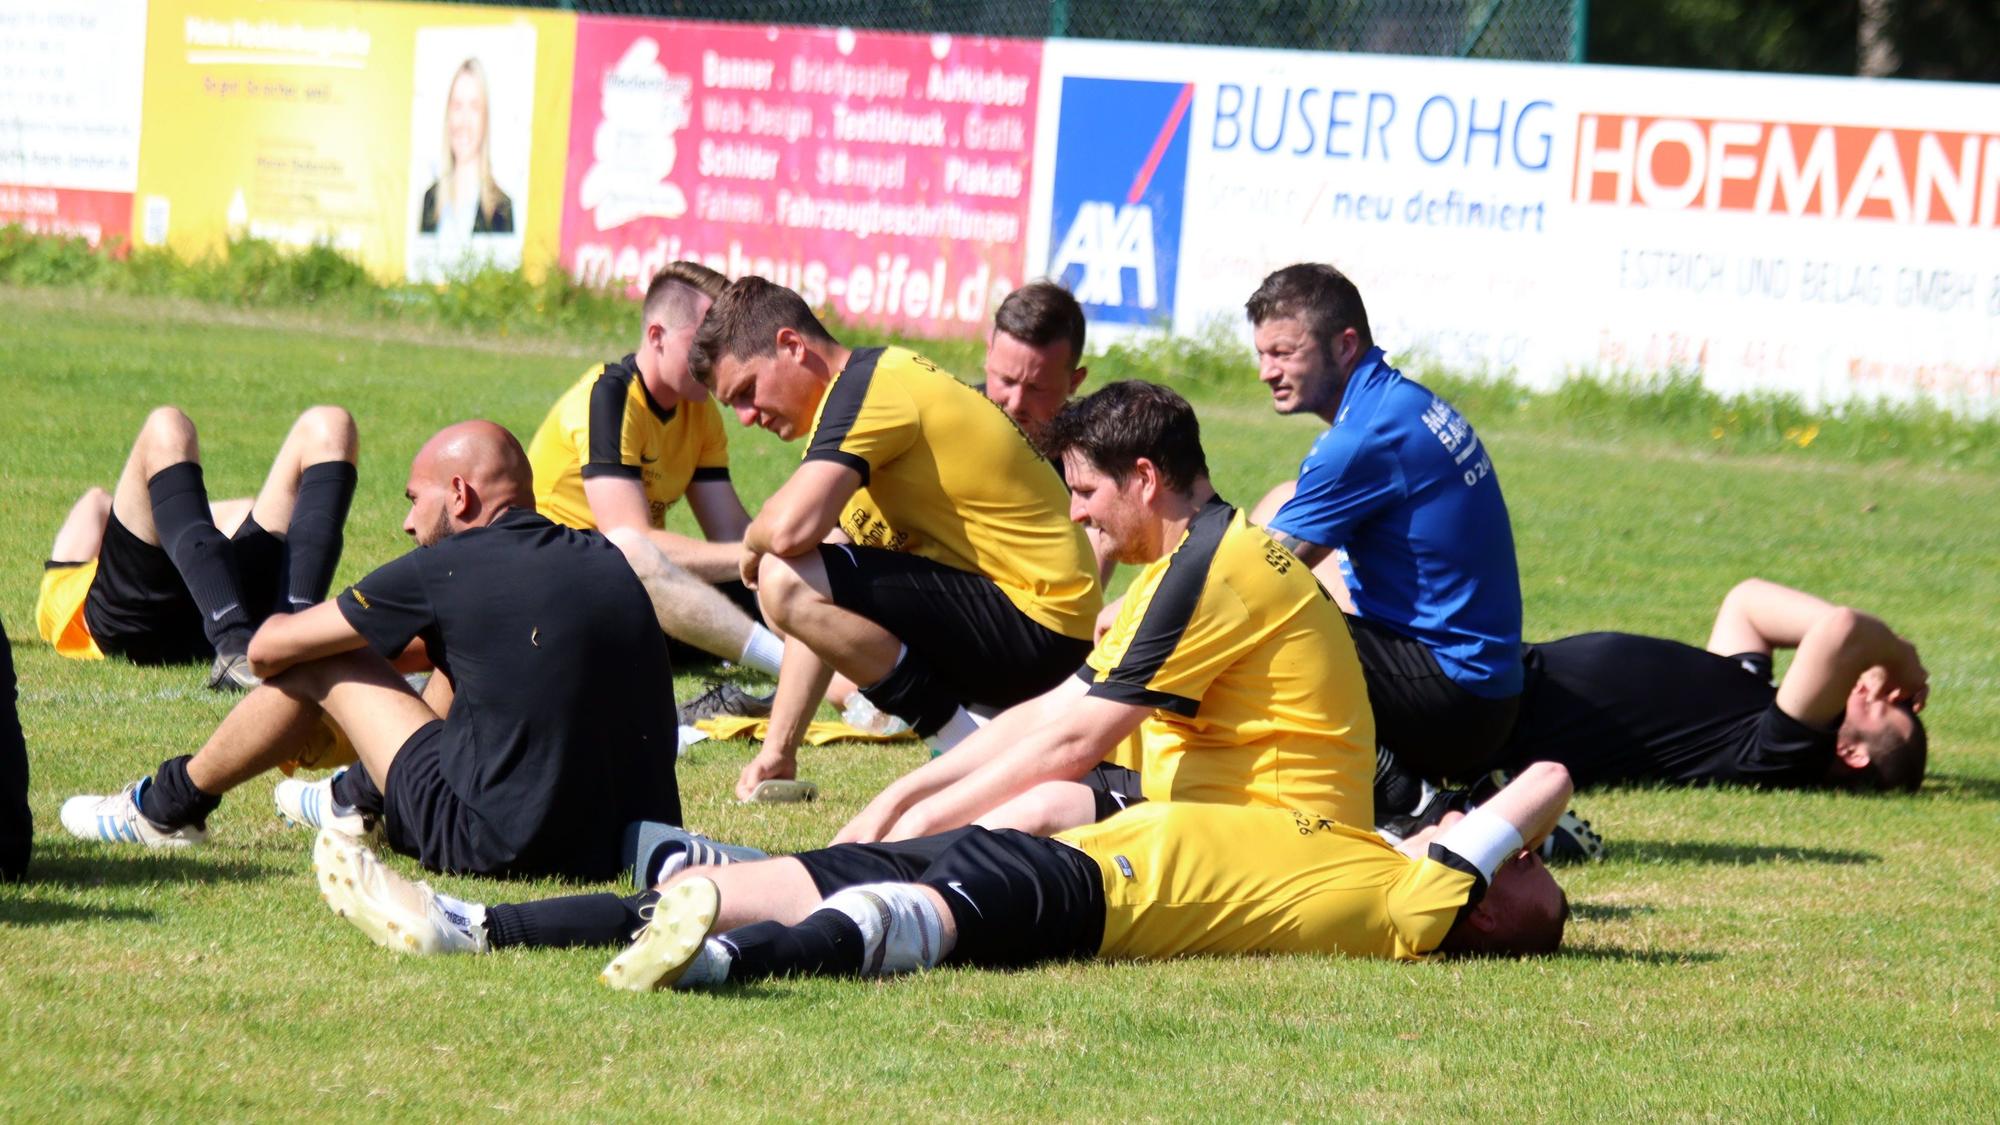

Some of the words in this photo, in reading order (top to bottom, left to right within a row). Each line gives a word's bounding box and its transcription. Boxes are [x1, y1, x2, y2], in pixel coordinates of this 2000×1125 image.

[703, 49, 775, 91] Banner
[790, 54, 910, 103] Briefpapier
[926, 63, 1029, 107] Aufkleber
[702, 97, 813, 144] Web-Design
[832, 102, 946, 147] Textildruck
[963, 110, 1025, 152] Grafik
[1211, 67, 1398, 163] BÜSER
[1415, 92, 1557, 173] OHG
[698, 138, 780, 181] Schilder
[944, 156, 1023, 199] Plakate
[1331, 189, 1394, 223] neu
[1402, 187, 1547, 234] definiert
[1047, 200, 1158, 310] AXA
[1618, 248, 1727, 295] ESTRICH
[1735, 255, 1790, 301] UND
[1801, 260, 1883, 307] BELAG
